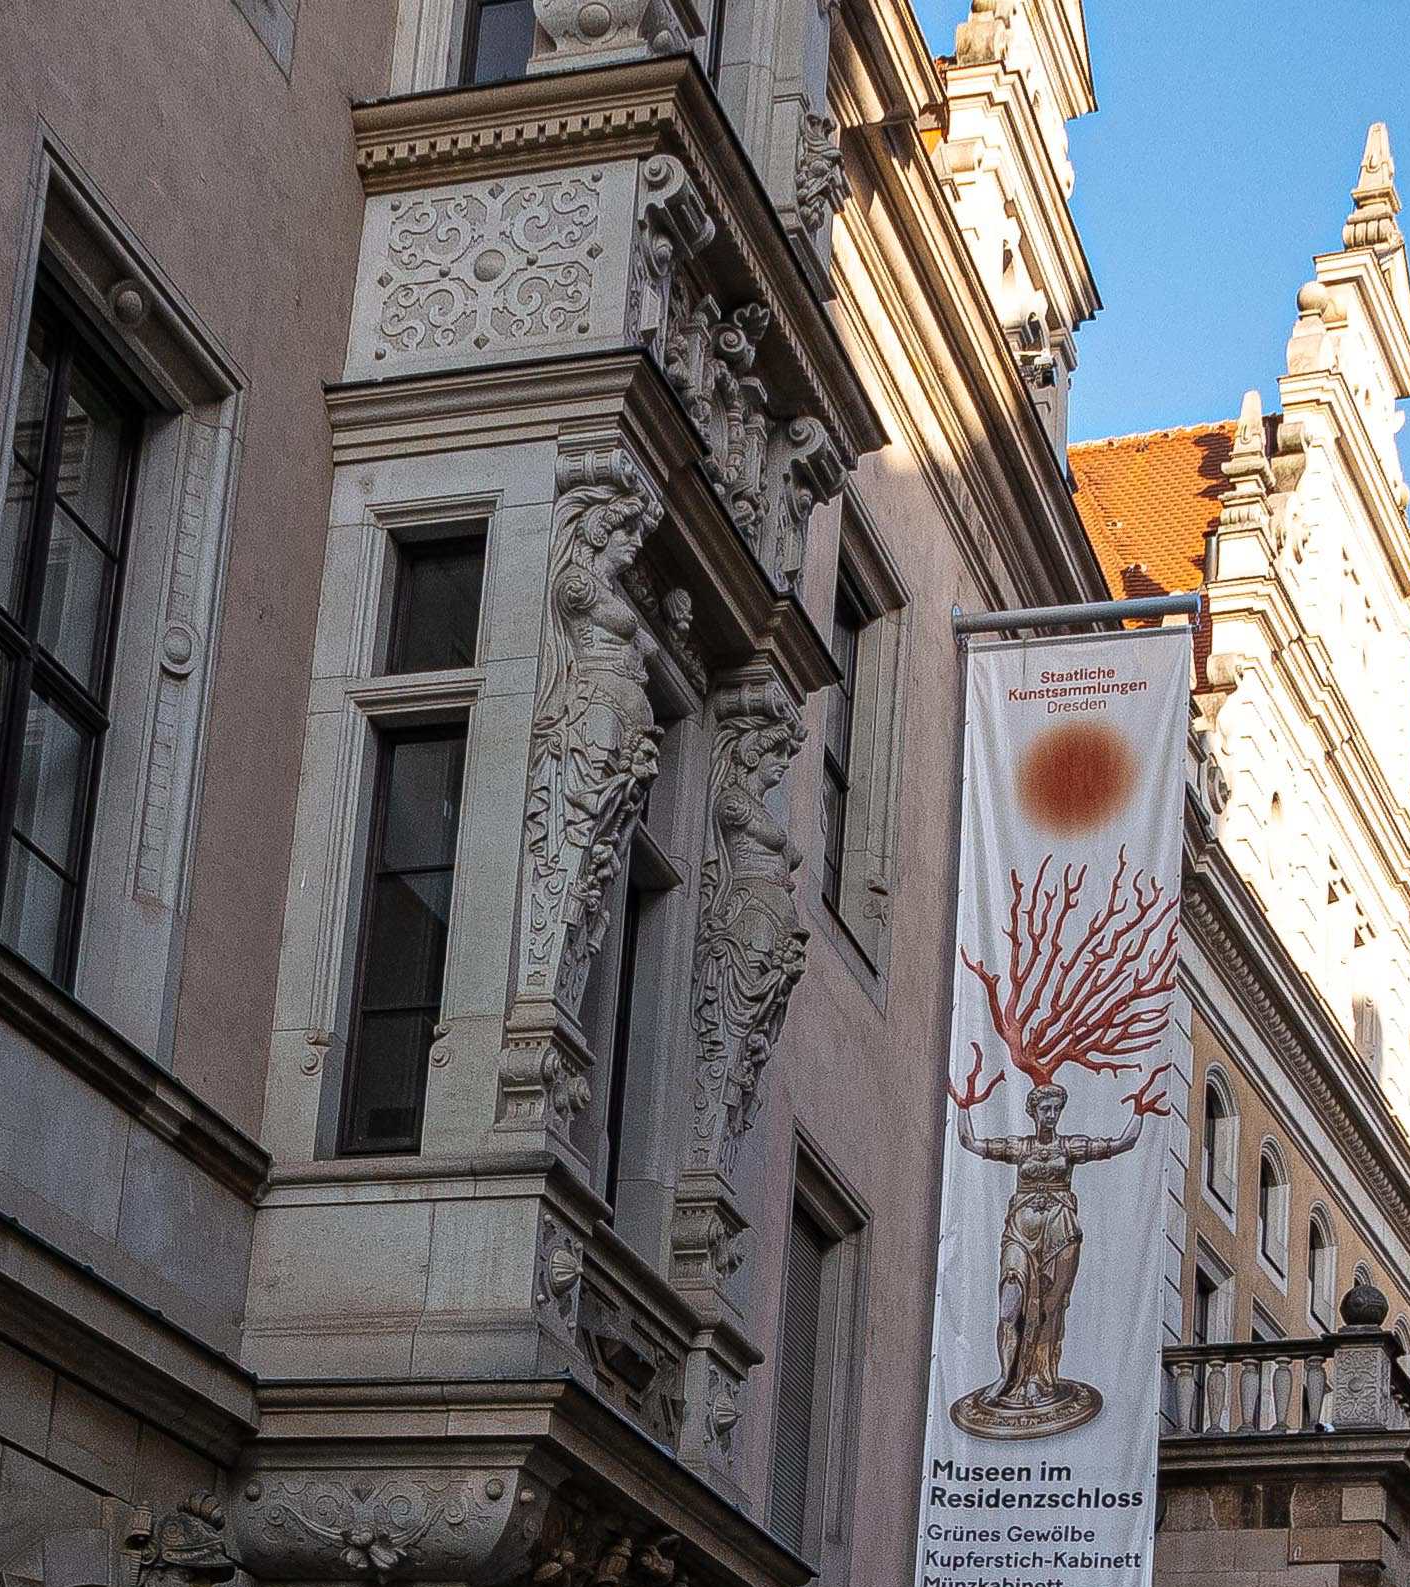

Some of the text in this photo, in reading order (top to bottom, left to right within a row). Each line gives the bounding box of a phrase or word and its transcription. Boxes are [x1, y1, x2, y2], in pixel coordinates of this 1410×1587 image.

[1040, 667, 1115, 684] Staatliche
[1008, 680, 1147, 702] Kunstsammlungen
[1047, 698, 1107, 714] Dresden
[932, 1459, 1071, 1482] Museen im
[930, 1486, 1143, 1509] Residenzschloss
[926, 1524, 1095, 1543] Grünes Gewölbe
[925, 1549, 1142, 1571] Kupferstich-Kabinett
